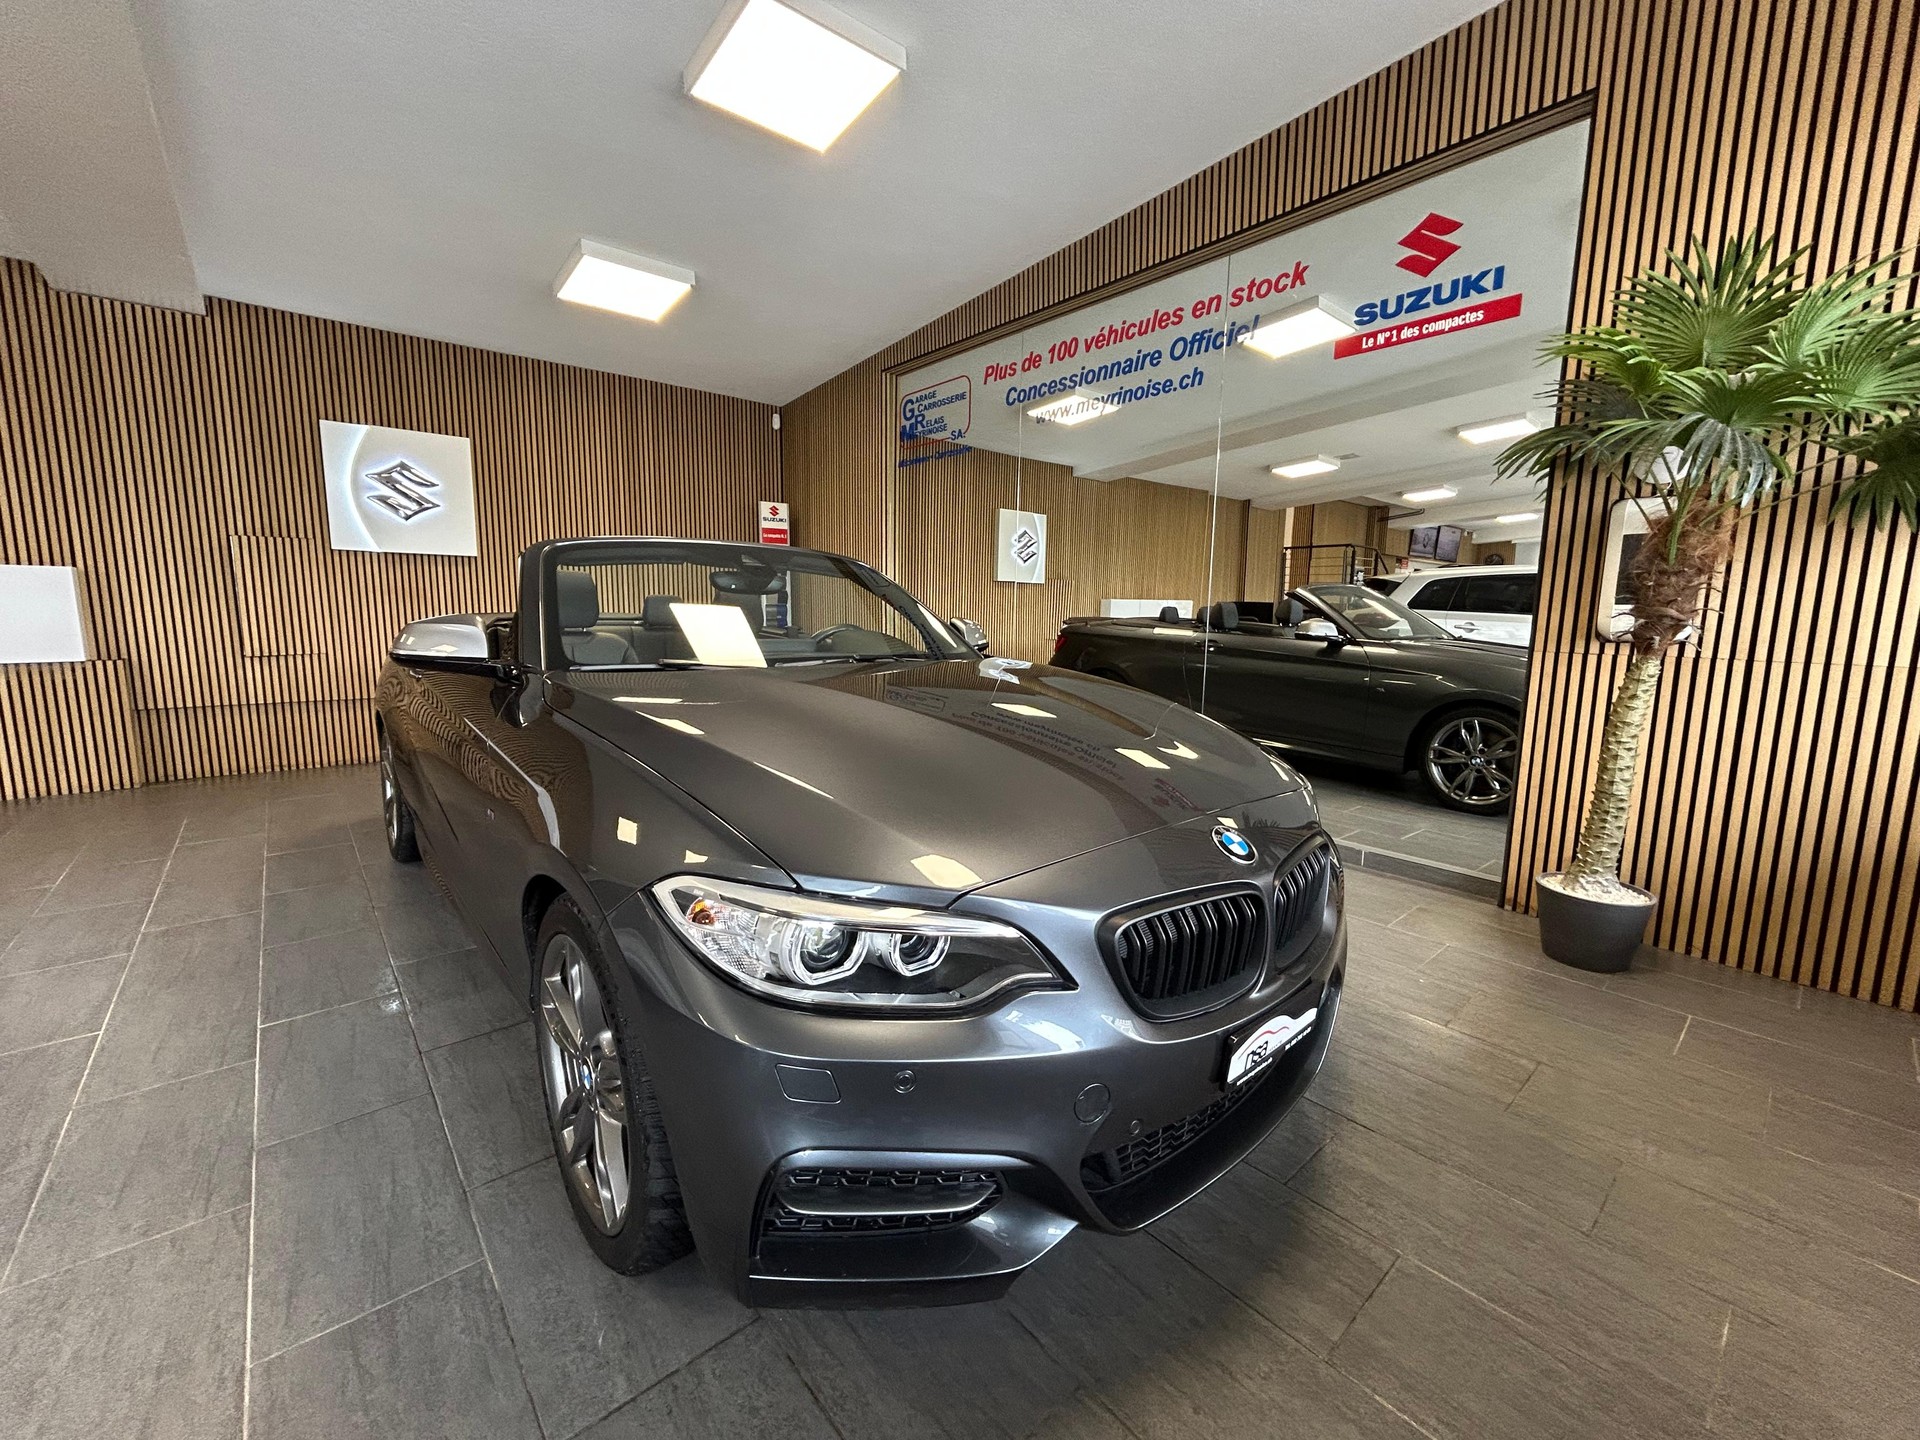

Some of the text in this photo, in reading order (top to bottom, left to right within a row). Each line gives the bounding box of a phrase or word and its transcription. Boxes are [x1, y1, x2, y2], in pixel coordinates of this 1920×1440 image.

[1353, 265, 1505, 327] SUZUKI
[983, 260, 1310, 385] Plus de 100 véhicules en stock
[1362, 336, 1374, 349] Le
[1400, 326, 1420, 340] des
[1422, 309, 1484, 336] compactes
[1005, 314, 1261, 407] Concessionnaire Officiel
[902, 390, 937, 422] GARAGE
[917, 391, 967, 413] CARROSSERIE
[1035, 366, 1204, 424] www.meyrinoise.ch
[915, 413, 945, 430] RELAIS
